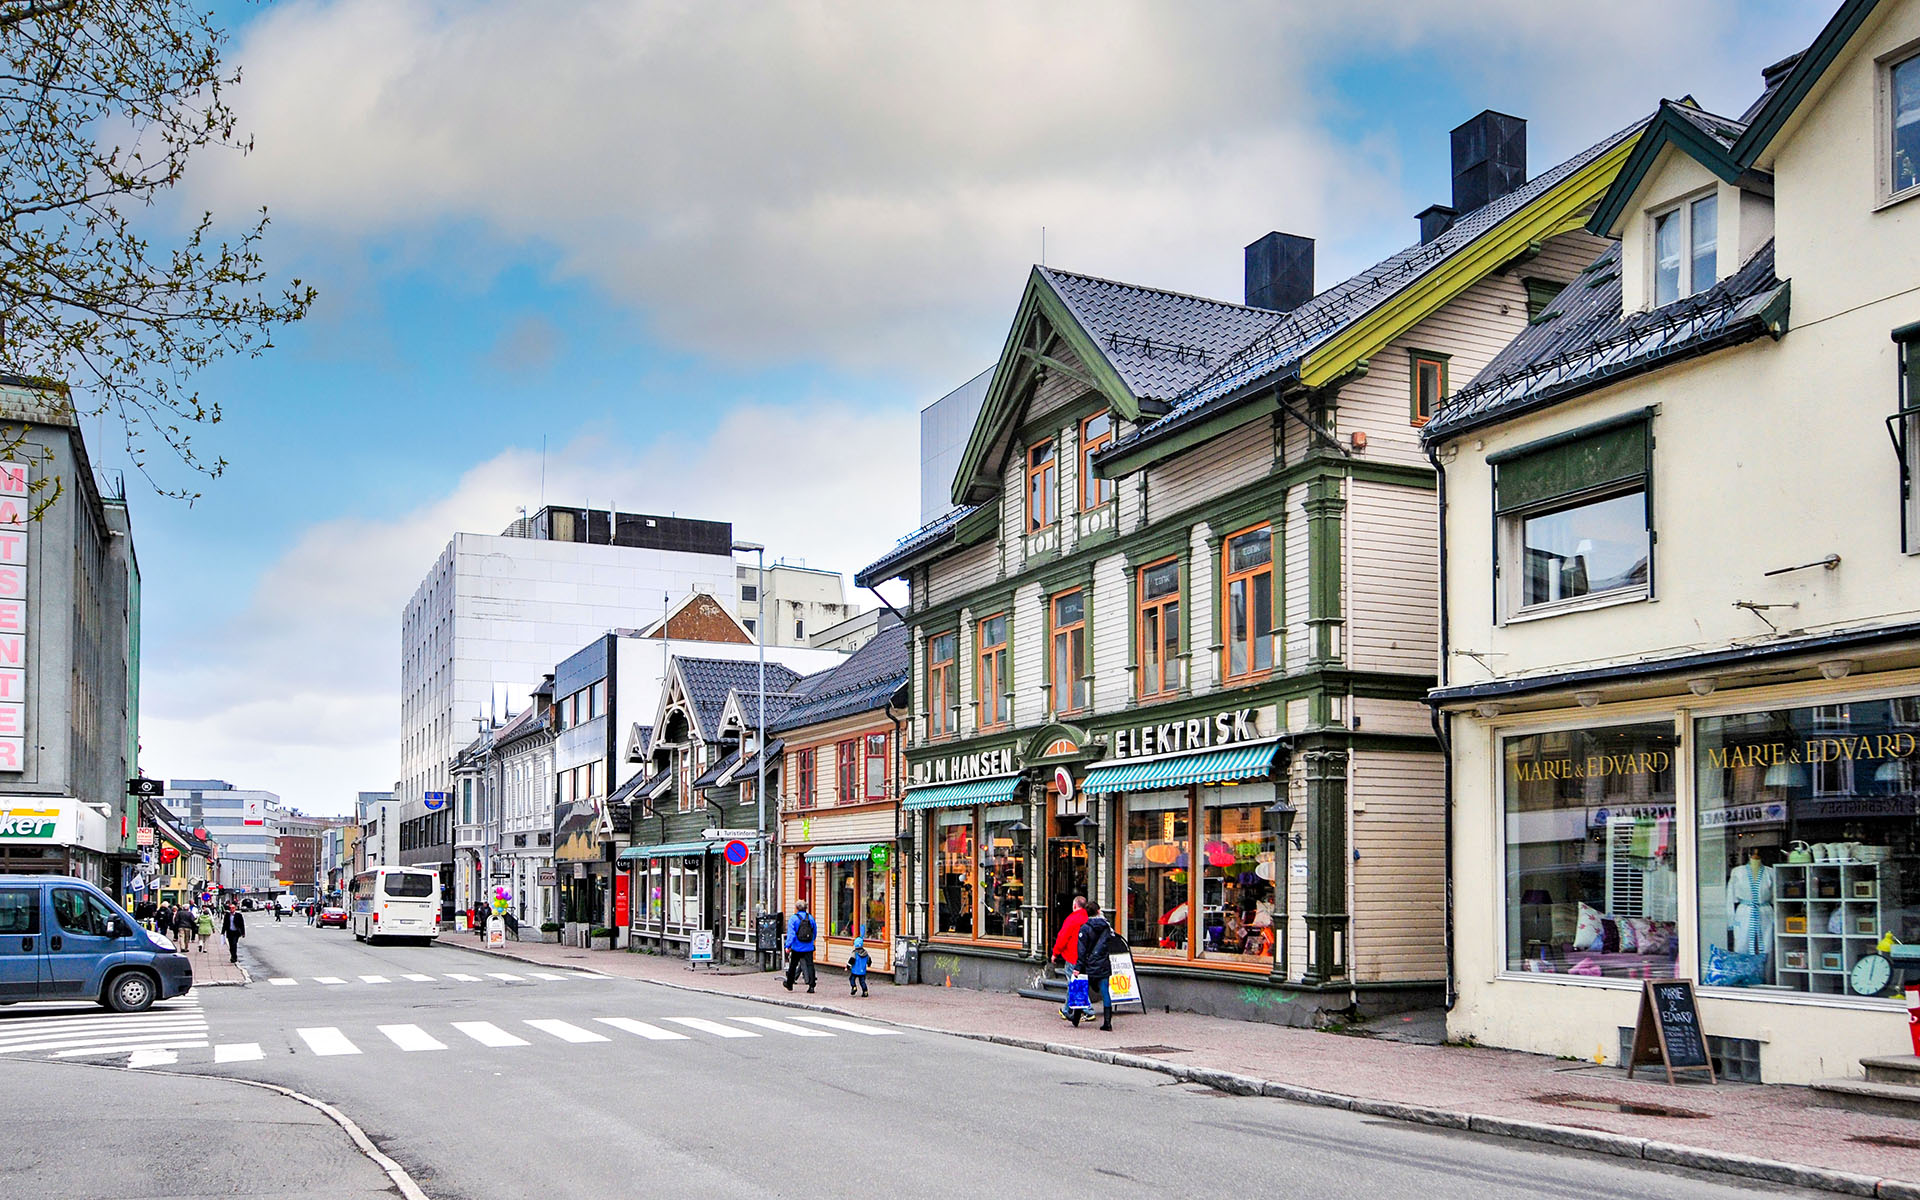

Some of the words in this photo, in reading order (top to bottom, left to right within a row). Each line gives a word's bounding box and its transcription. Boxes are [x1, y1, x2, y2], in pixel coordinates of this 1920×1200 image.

[1115, 708, 1251, 758] ELEKTRISK
[1708, 743, 1786, 769] MARIE
[1789, 748, 1801, 764] &
[1804, 732, 1916, 763] EDVARD
[924, 760, 932, 783] J
[935, 758, 946, 783] M
[951, 748, 1012, 781] HANSEN
[1513, 759, 1572, 782] MARIE
[1574, 763, 1584, 778] &
[1586, 751, 1669, 777] EDVARD
[1669, 1000, 1677, 1011] &
